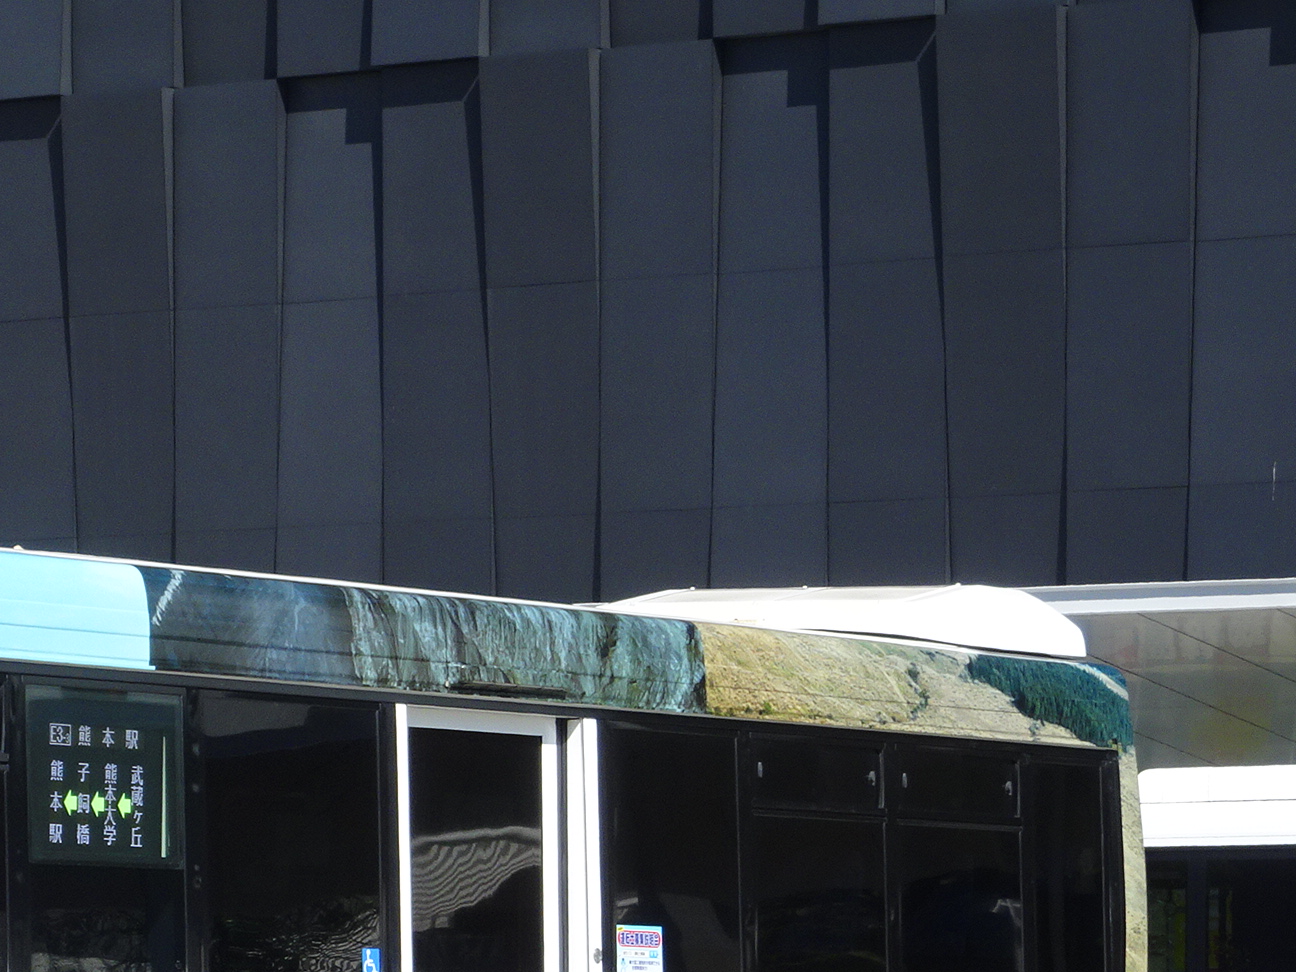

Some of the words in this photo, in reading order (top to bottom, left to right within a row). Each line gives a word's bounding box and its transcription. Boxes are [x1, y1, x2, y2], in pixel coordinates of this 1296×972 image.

[78, 725, 139, 749] 熊本駅
[48, 759, 64, 844] 熊本駅
[77, 762, 91, 845] 子飼橋
[103, 762, 118, 846] 熊本大学
